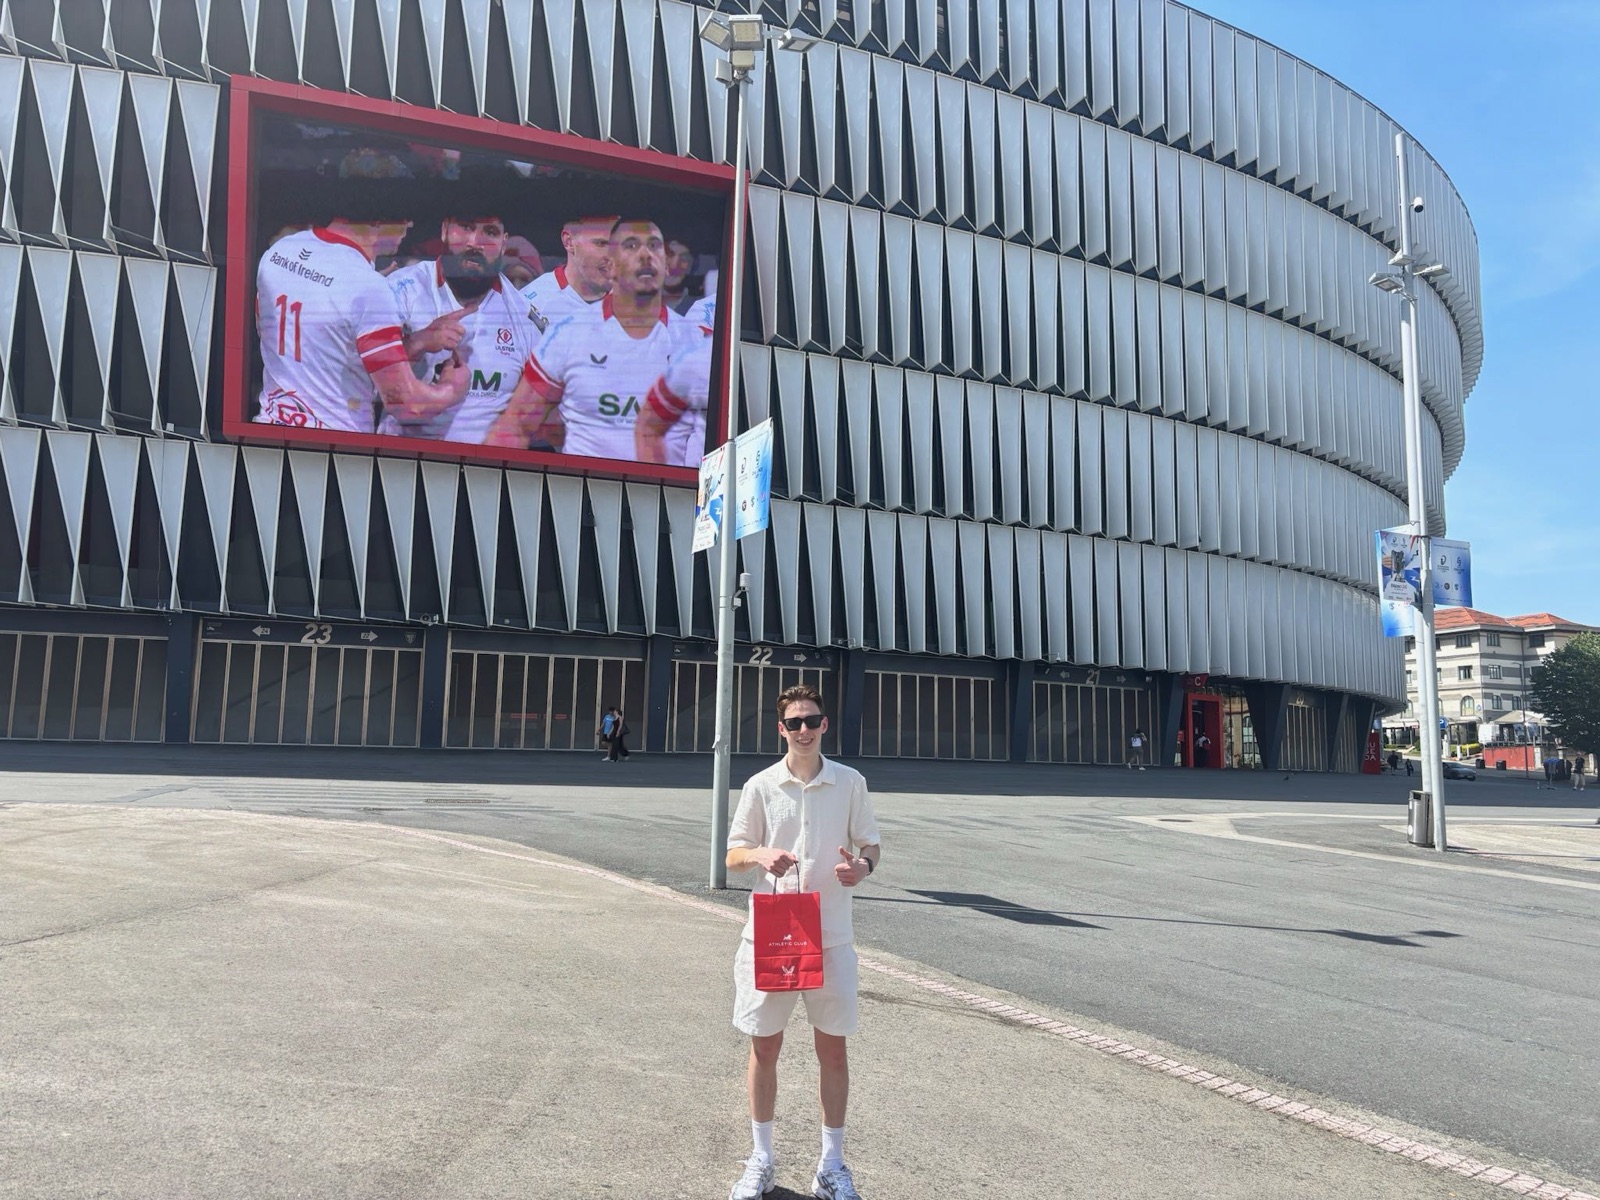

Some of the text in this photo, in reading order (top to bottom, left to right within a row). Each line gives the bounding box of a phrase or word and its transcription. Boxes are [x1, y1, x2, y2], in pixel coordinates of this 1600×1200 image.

[270, 252, 334, 288] Bank of Ireland
[276, 294, 302, 363] 11
[598, 393, 641, 417] SA
[300, 623, 333, 645] 23
[748, 646, 774, 665] 22
[1085, 668, 1101, 684] 21
[1195, 676, 1202, 686] C
